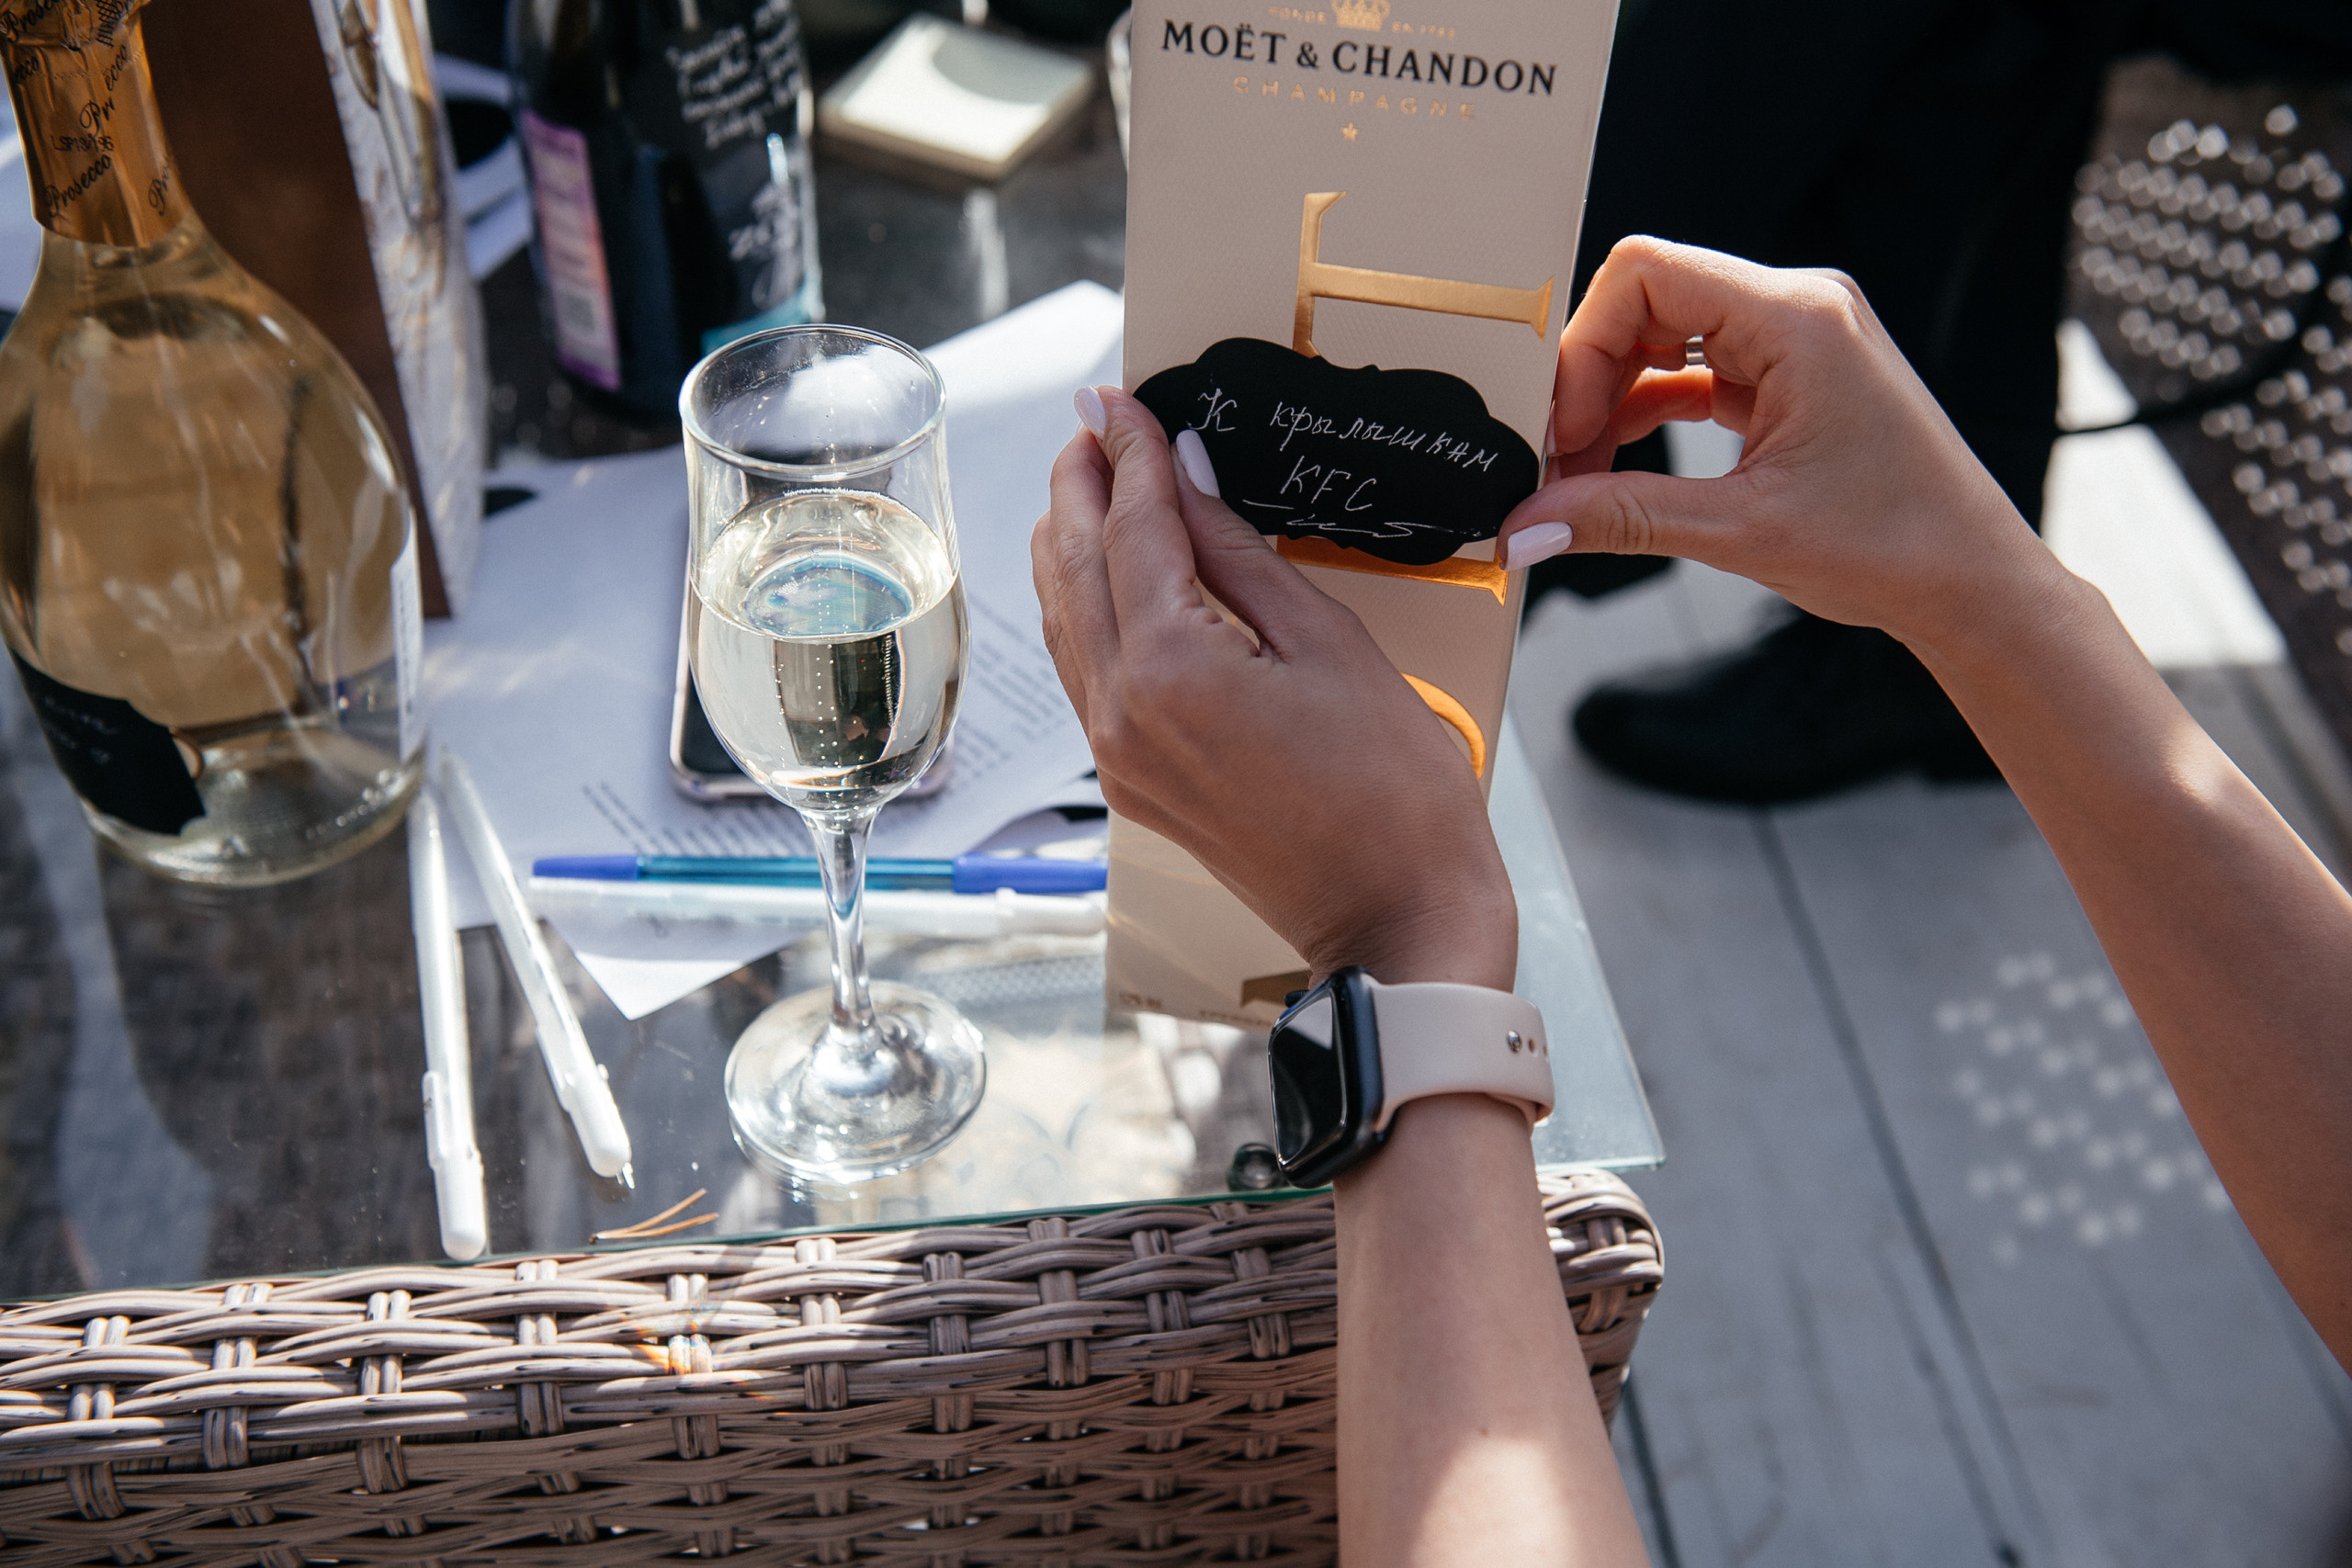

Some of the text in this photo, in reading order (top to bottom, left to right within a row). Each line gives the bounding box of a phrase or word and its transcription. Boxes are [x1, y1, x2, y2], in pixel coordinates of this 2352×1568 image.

[1162, 18, 1557, 96] MOËT & CHANDON
[1233, 75, 1476, 120] CHAMPAGNE
[44, 153, 112, 219] Prosecco
[1280, 456, 1377, 512] KFC
